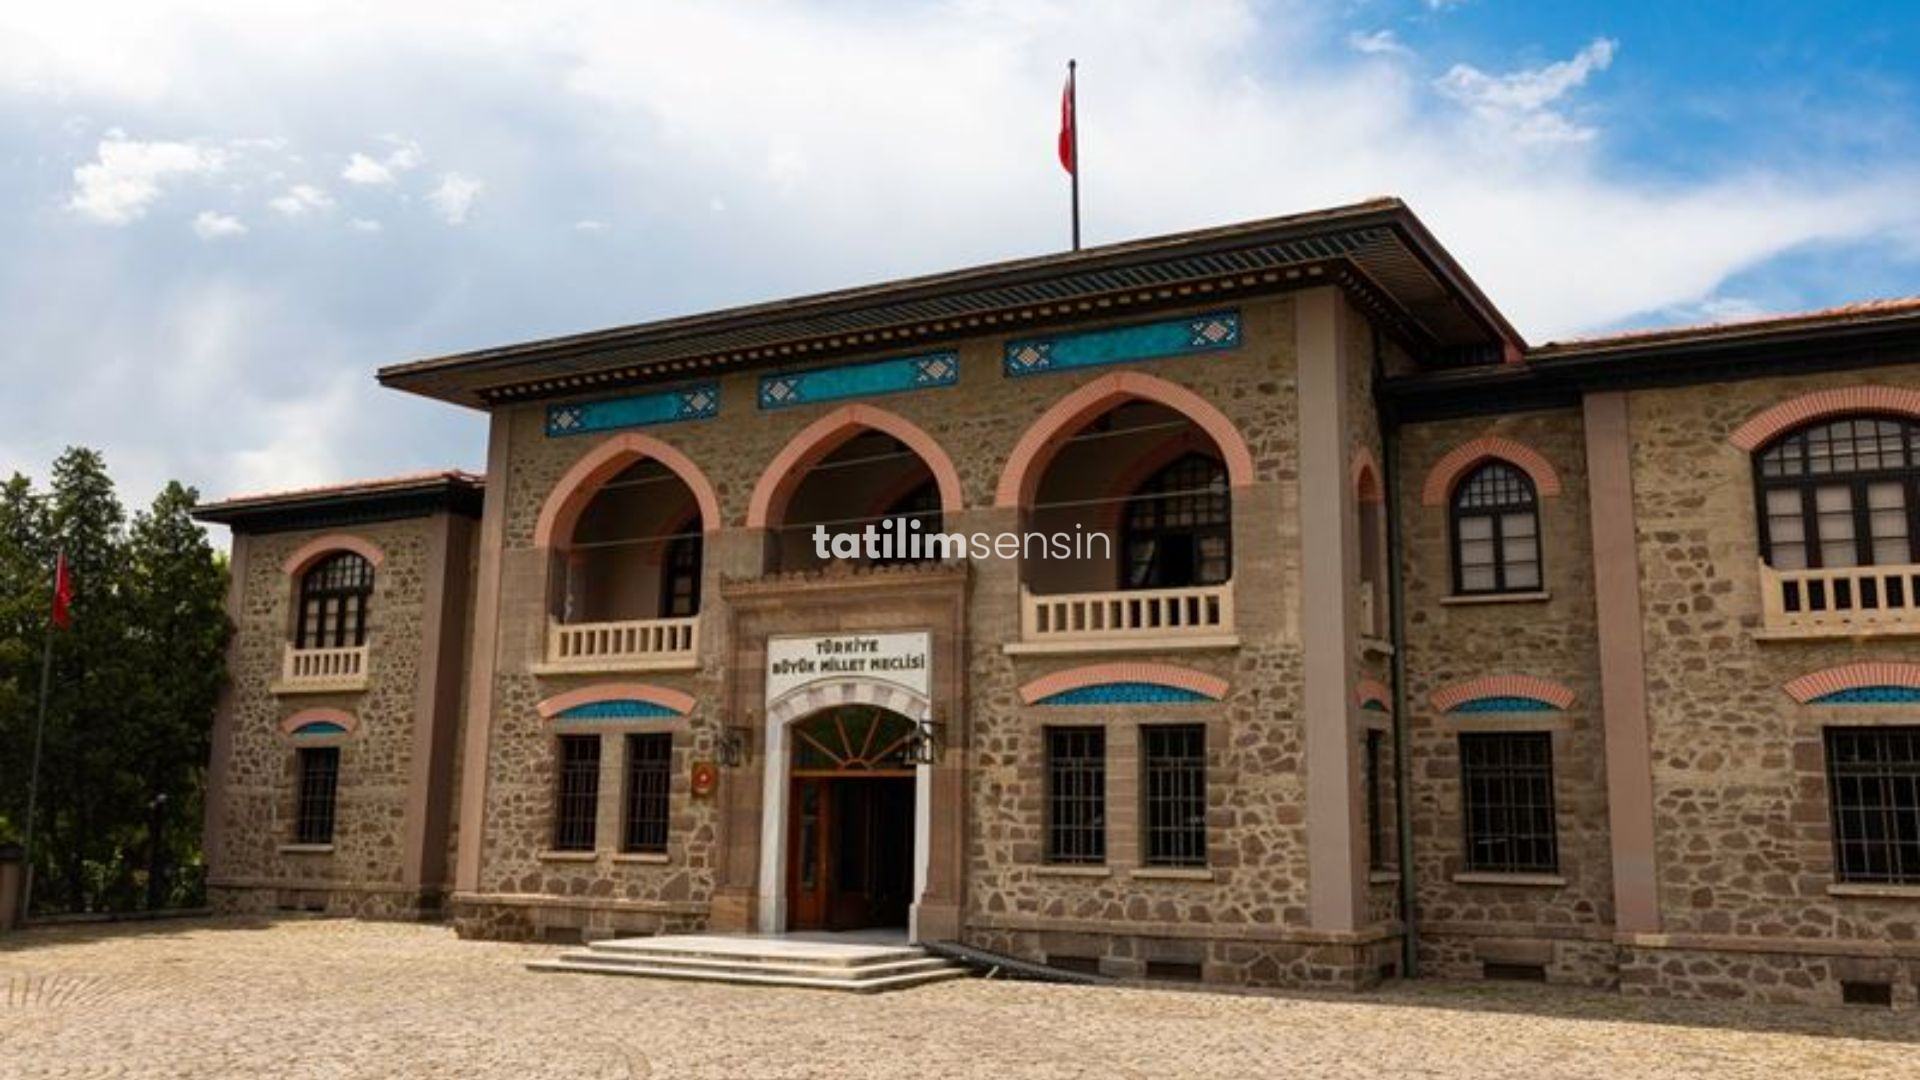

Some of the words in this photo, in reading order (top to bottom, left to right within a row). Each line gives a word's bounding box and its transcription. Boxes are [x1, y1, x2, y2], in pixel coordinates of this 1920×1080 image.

[816, 638, 879, 654] TÜRKİYE
[772, 658, 815, 674] BÜYÜK
[820, 657, 865, 672] MİLLET
[870, 654, 925, 670] MECLİSİ
